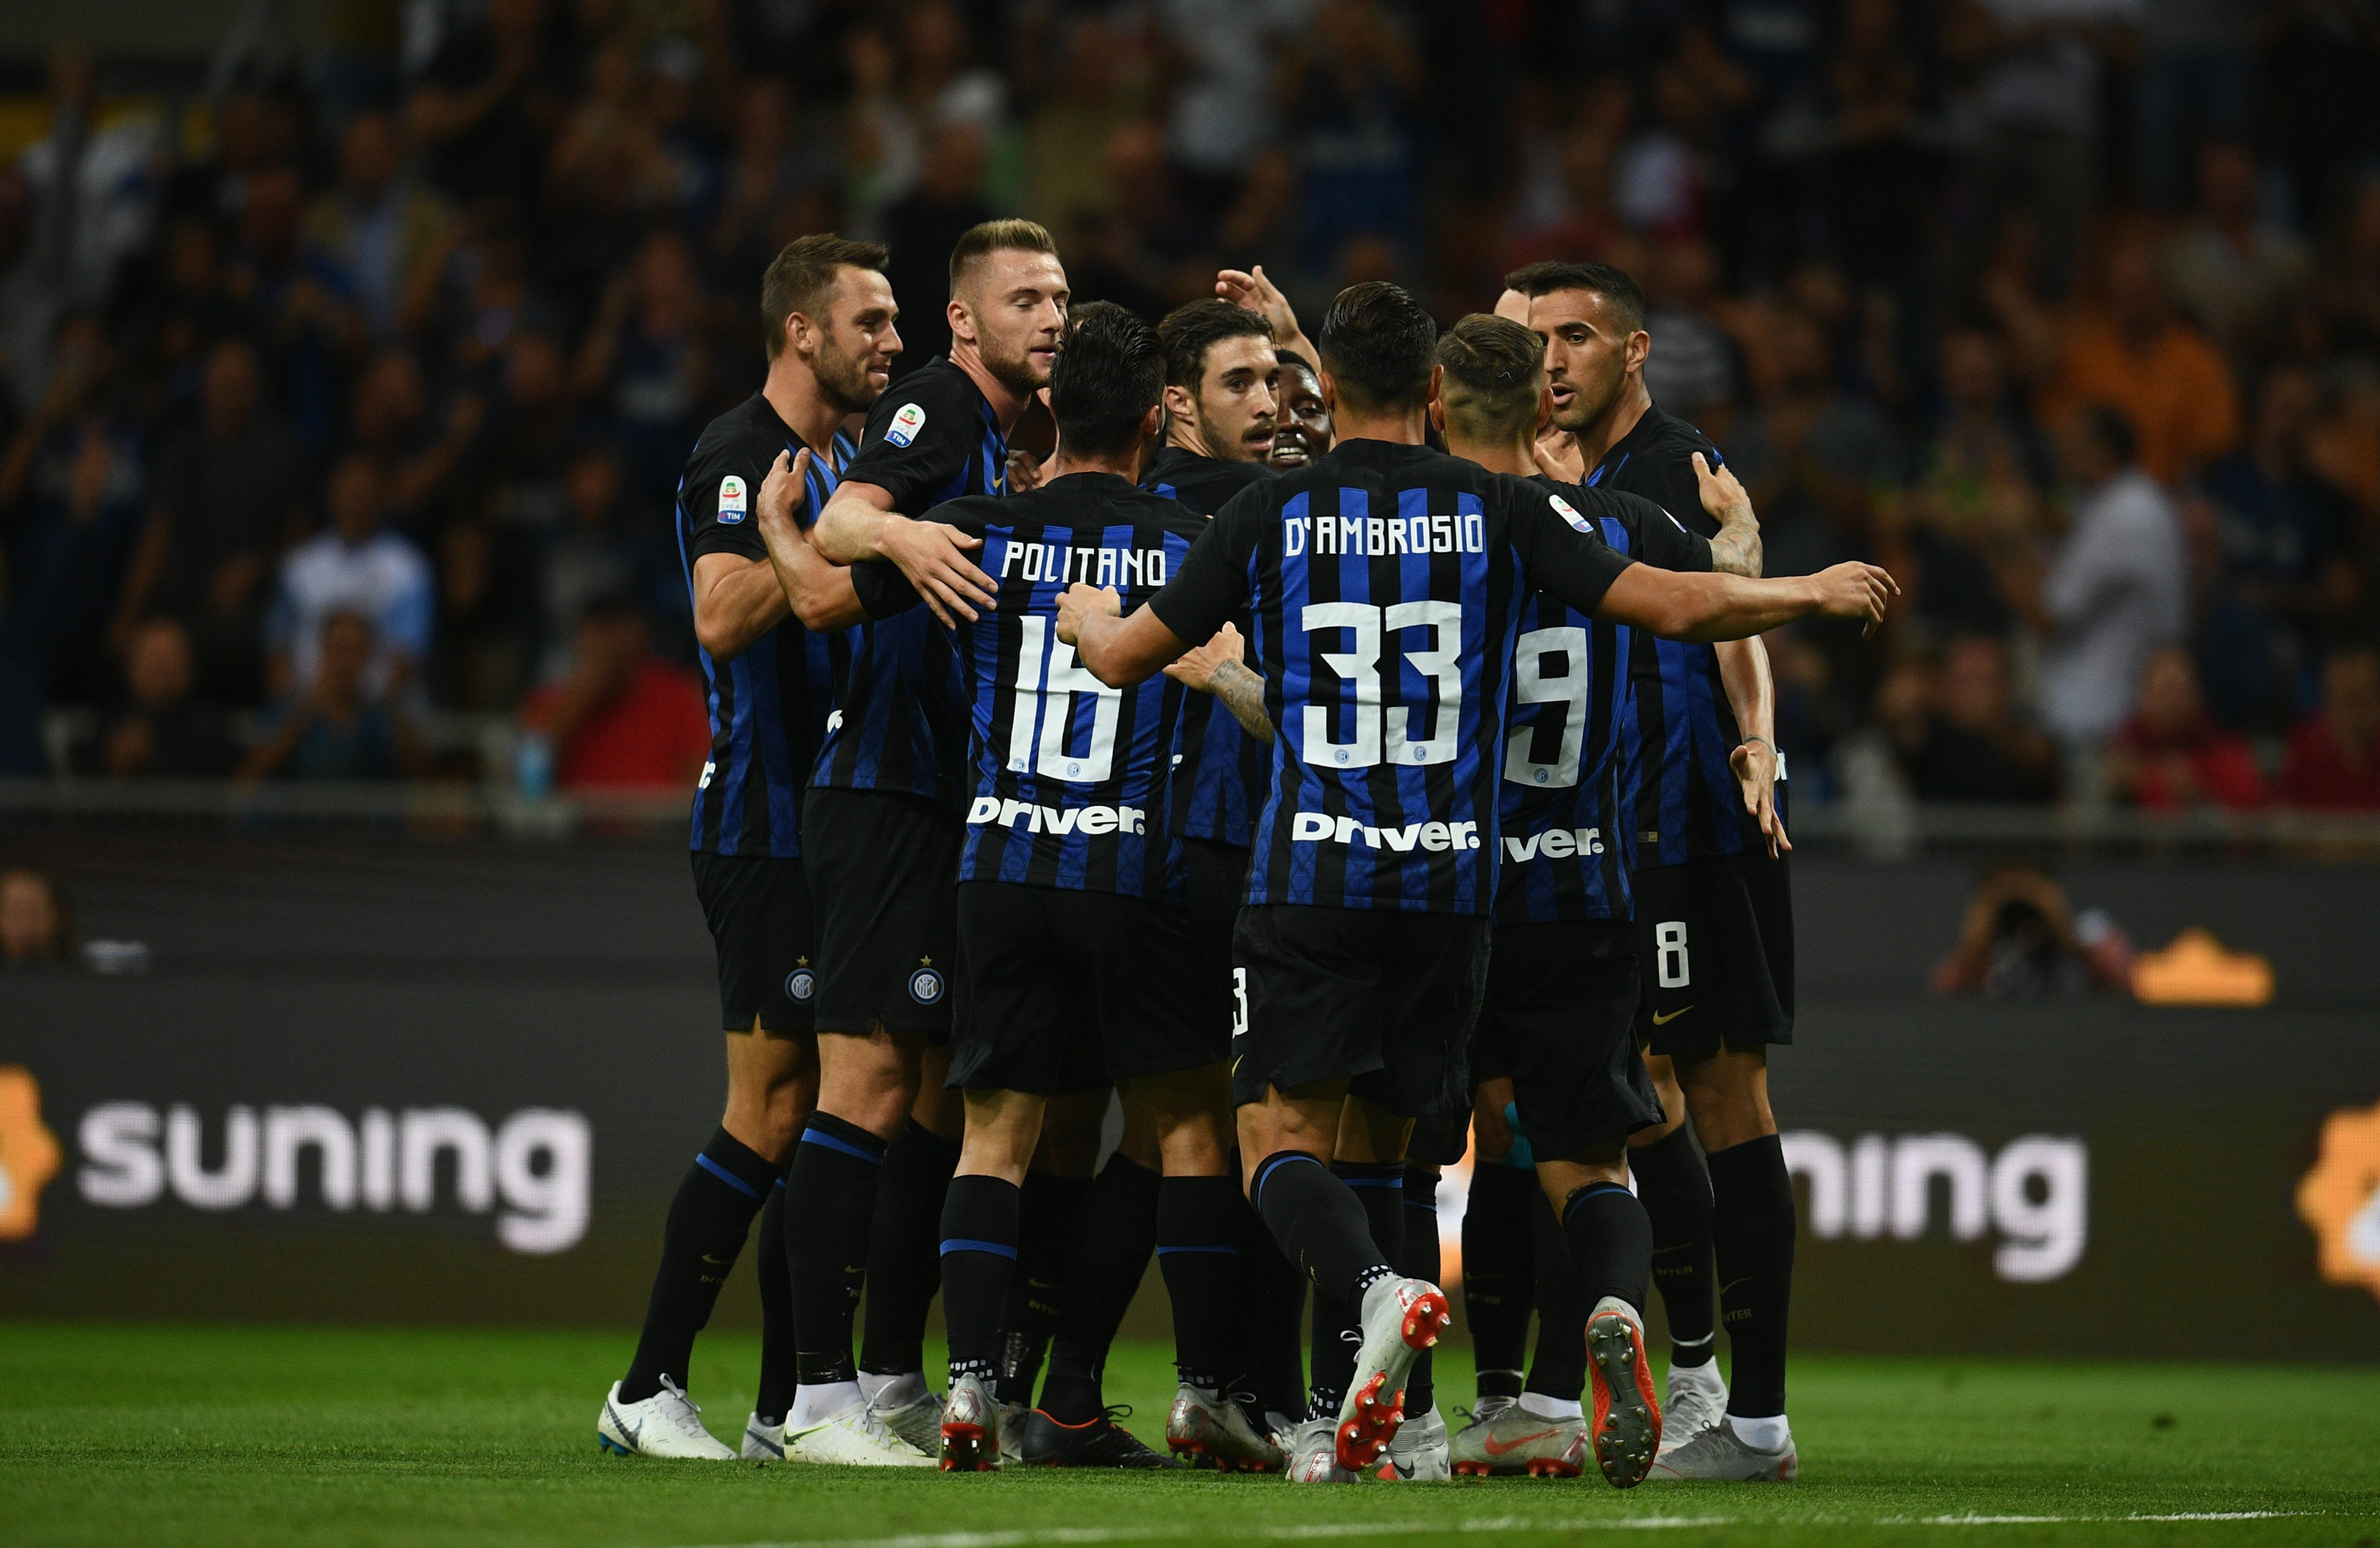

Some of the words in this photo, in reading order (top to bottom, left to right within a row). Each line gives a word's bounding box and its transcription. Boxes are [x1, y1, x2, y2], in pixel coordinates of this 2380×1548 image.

[893, 432, 906, 445] TIM
[727, 512, 741, 520] TIM
[1284, 514, 1483, 557] D'AMBROSIO
[1000, 541, 1166, 586] POLITANO
[1006, 615, 1123, 783] 16
[1302, 600, 1462, 769] 33
[1504, 627, 1587, 788] 9
[1500, 828, 1604, 863] ver.
[1656, 921, 1690, 989] 8
[78, 1101, 593, 1255] suning
[1779, 1130, 2089, 1283] ning
[1722, 1308, 1752, 1323] NTER
